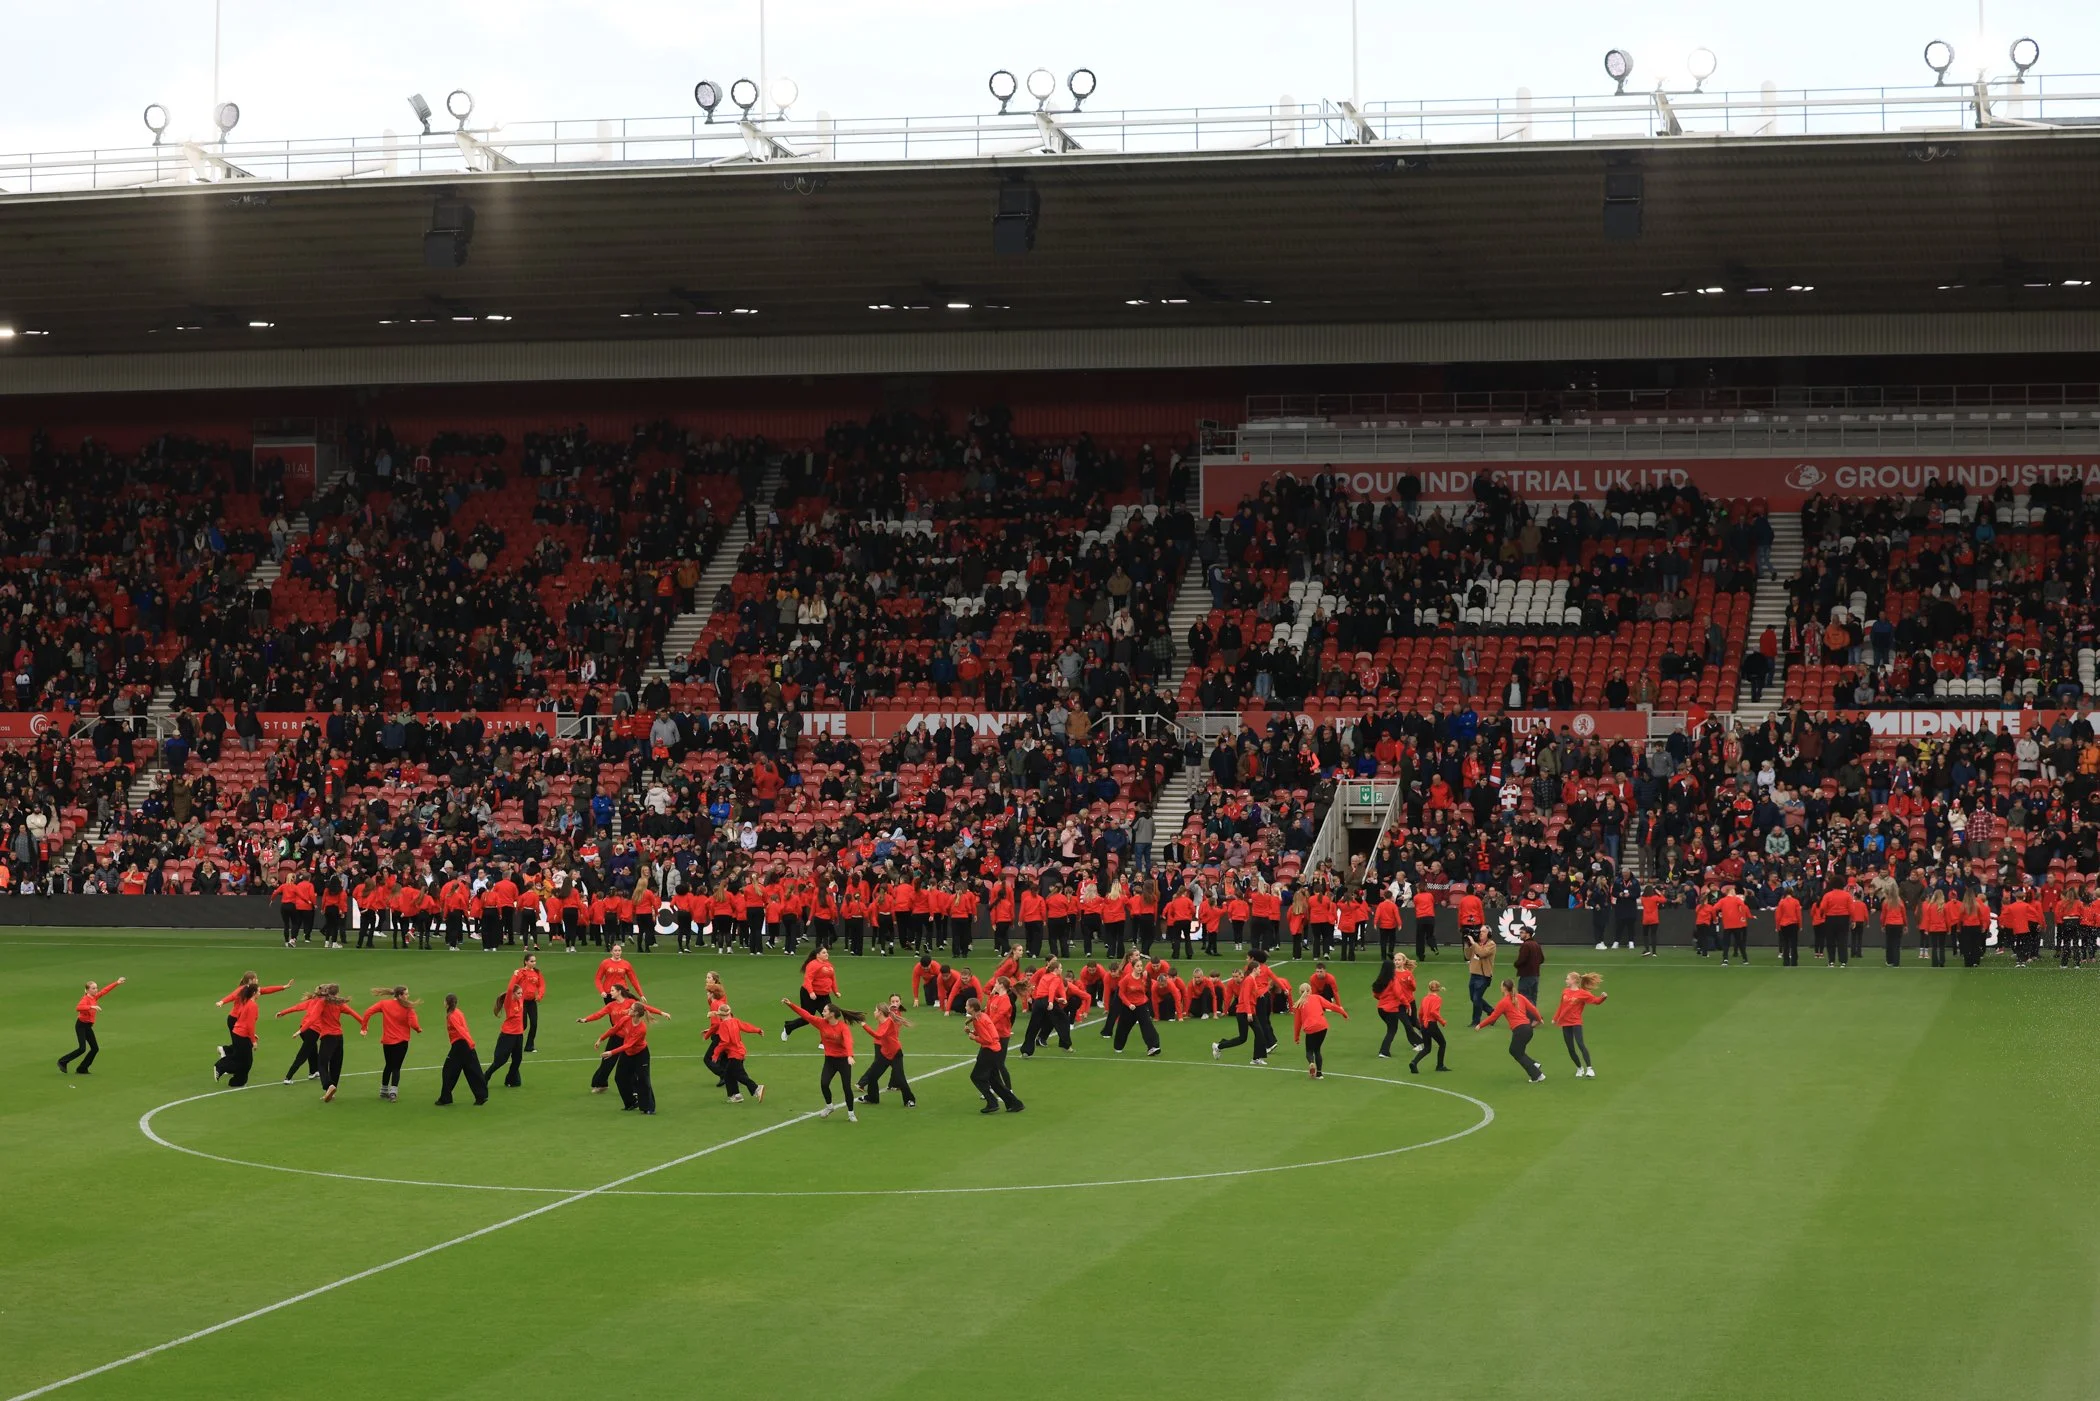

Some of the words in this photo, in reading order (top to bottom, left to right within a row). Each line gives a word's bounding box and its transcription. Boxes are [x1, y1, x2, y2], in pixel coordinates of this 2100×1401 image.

[1595, 469, 1633, 491] UK
[1835, 466, 1940, 488] GROUP
[1865, 711, 2021, 735] MIDNITE
